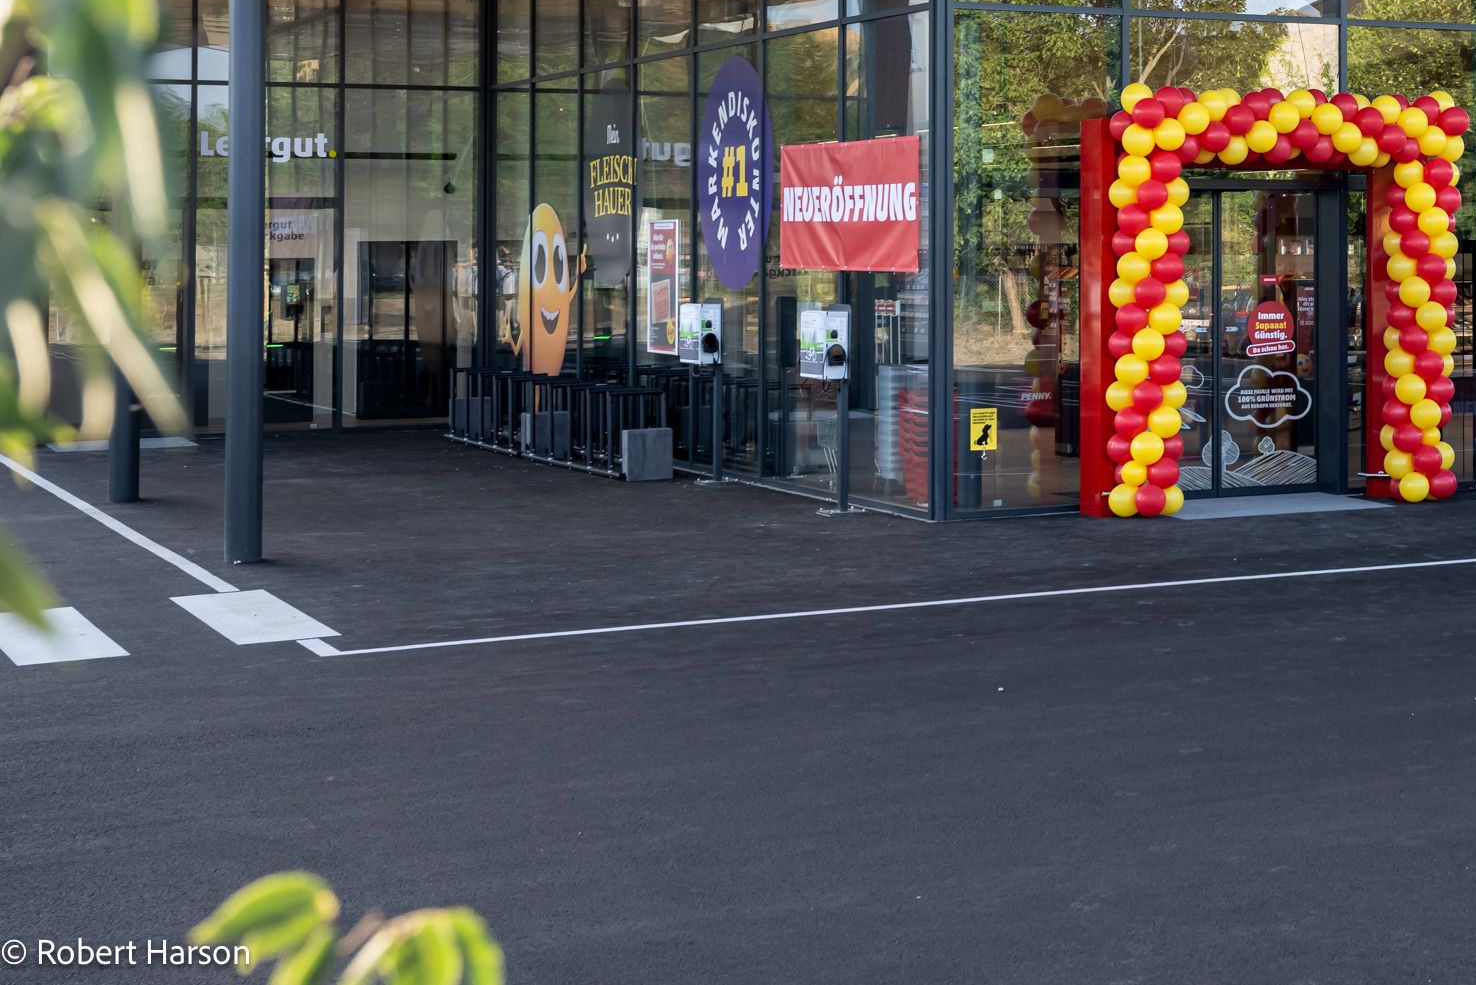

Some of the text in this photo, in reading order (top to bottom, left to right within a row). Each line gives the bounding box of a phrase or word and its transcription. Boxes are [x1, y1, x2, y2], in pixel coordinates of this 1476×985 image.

[721, 145, 749, 198] #1
[594, 187, 633, 218] HAUER
[783, 175, 917, 223] NEUERÖFFNUNG
[1255, 321, 1287, 331] Supaaa!
[1258, 312, 1285, 320] Immer
[1254, 330, 1288, 340] Günstig.
